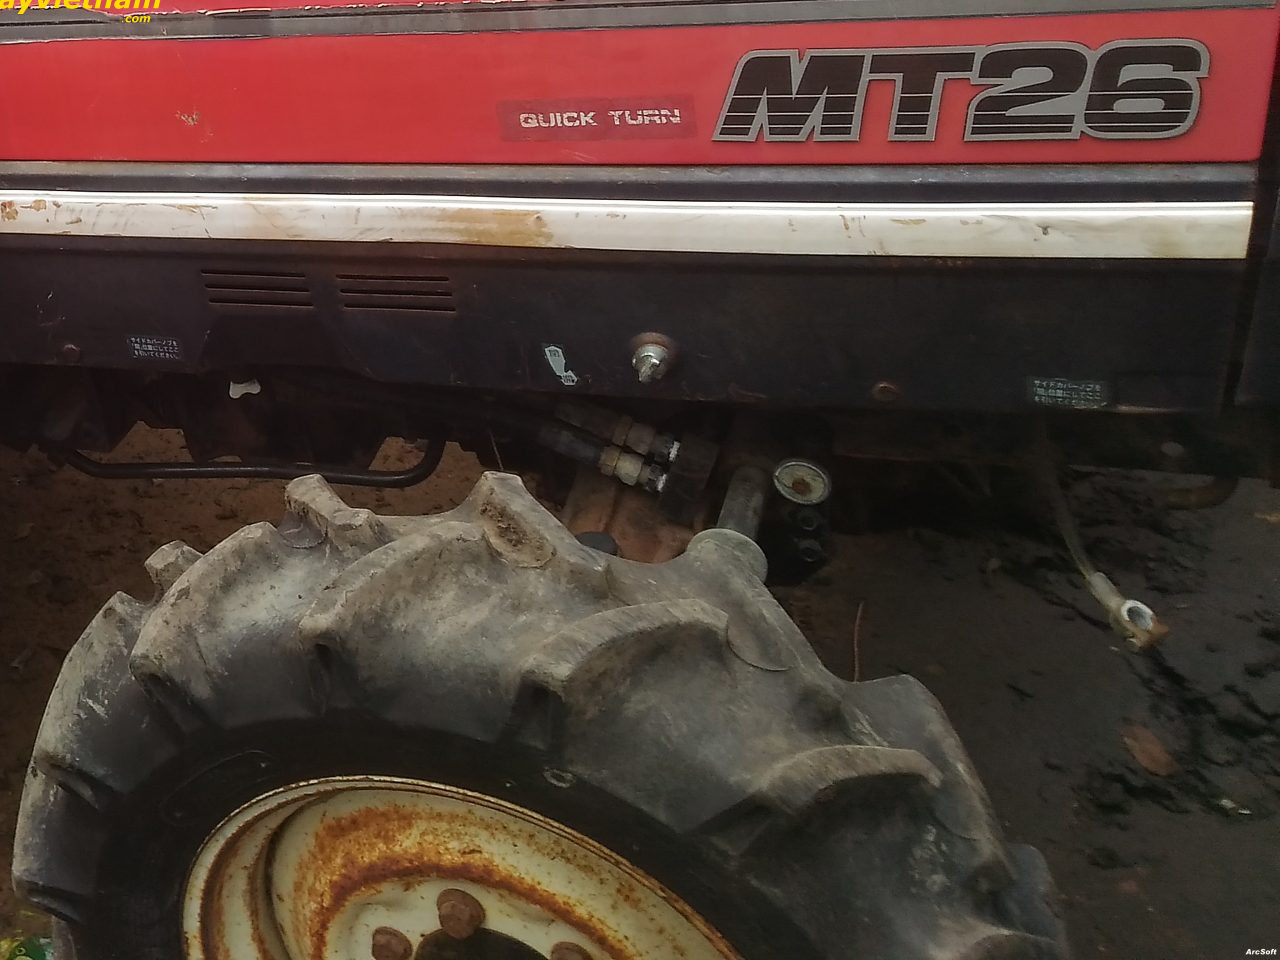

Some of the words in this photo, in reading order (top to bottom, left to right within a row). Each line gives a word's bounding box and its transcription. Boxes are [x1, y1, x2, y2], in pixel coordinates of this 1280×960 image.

[519, 111, 599, 128] QUICK
[608, 109, 681, 126] TURN
[712, 38, 1211, 143] MT26
